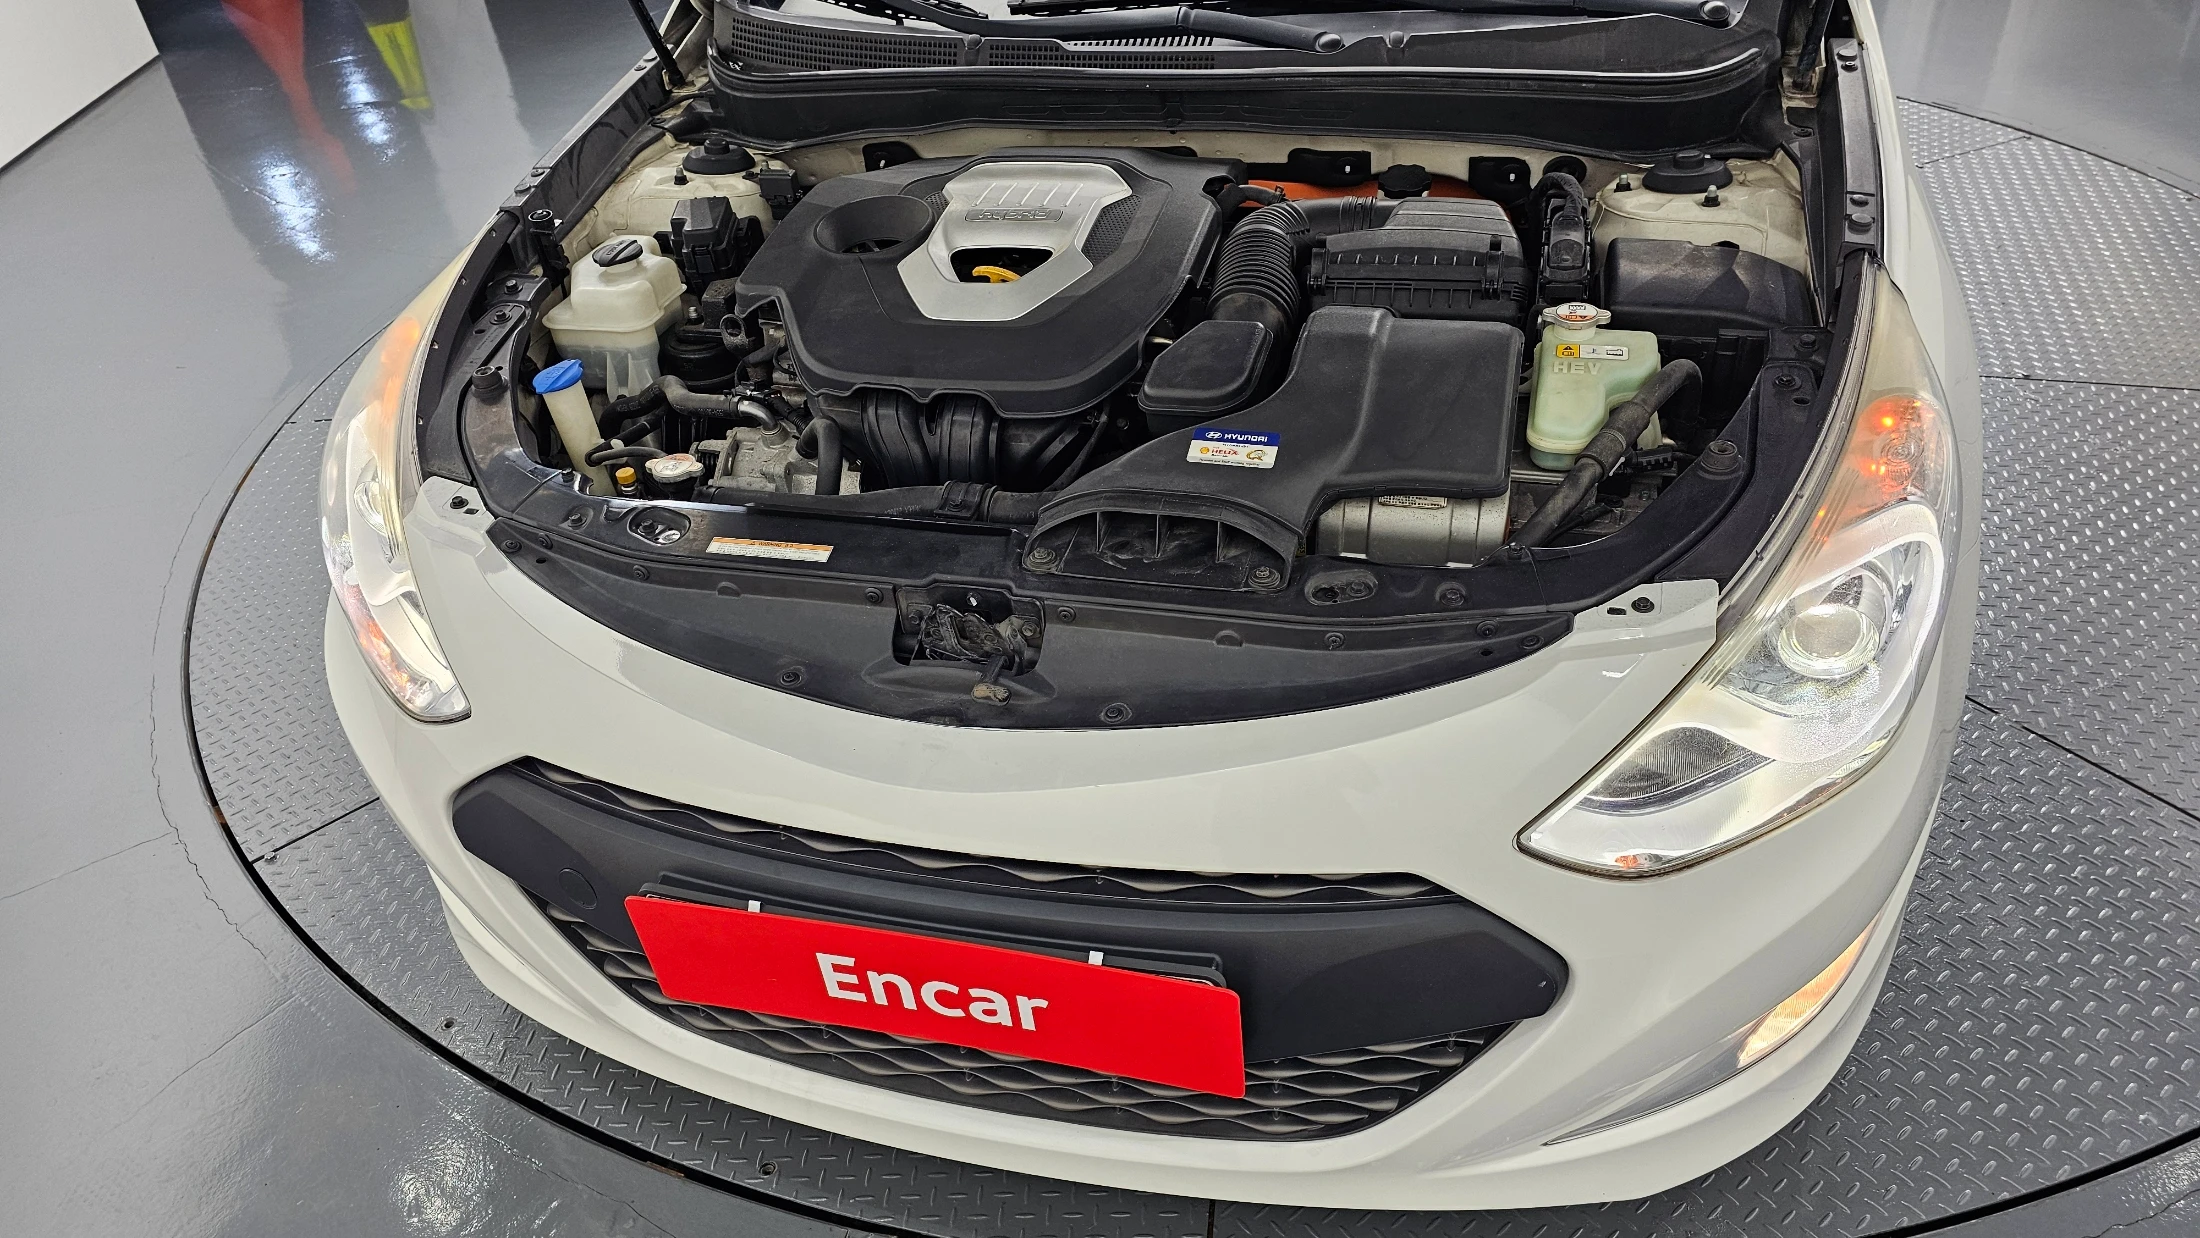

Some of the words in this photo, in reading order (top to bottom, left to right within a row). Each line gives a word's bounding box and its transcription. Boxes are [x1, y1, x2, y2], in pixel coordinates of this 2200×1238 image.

[1553, 361, 1601, 375] HEV
[1224, 433, 1268, 443] HYUNDAI
[815, 952, 1049, 1031] Encar
